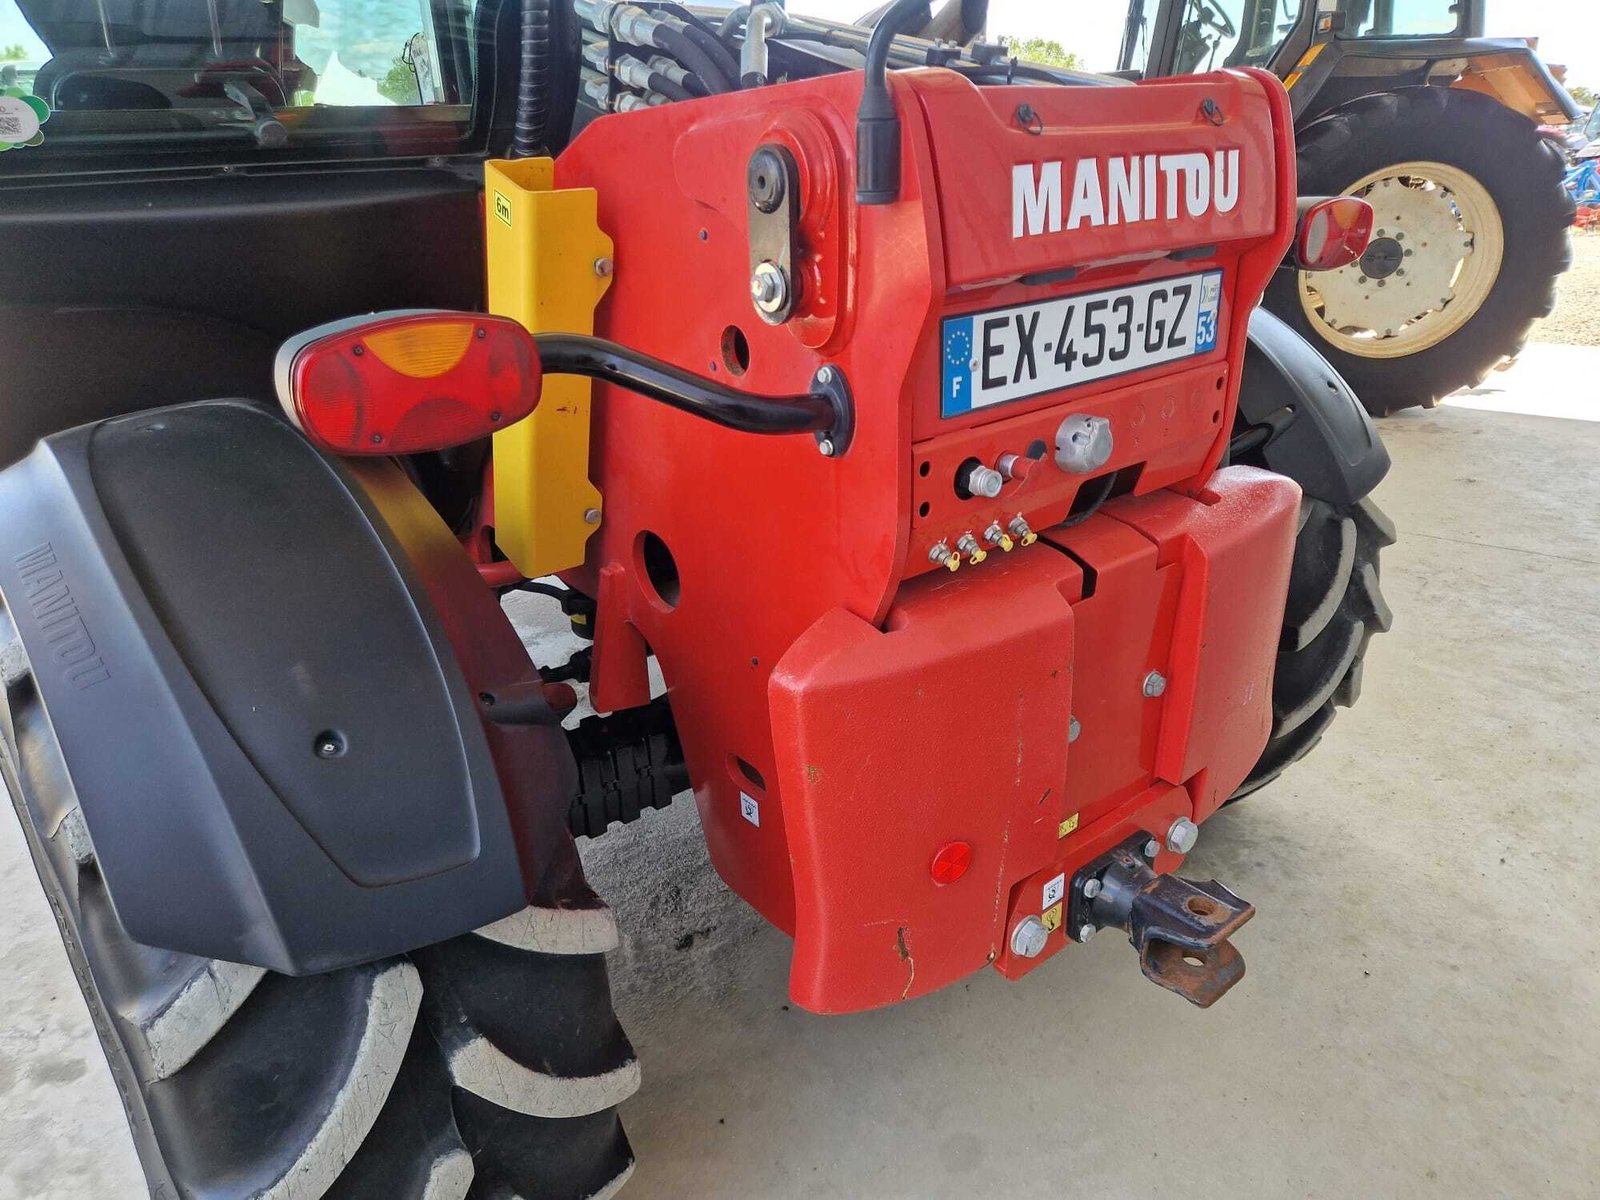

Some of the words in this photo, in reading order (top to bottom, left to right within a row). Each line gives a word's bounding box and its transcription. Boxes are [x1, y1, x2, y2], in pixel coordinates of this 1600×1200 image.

[496, 196, 509, 220] 6m
[1012, 150, 1239, 238] MANITOU
[982, 284, 1192, 390] EX-453-GZ
[1197, 313, 1215, 345] 53
[952, 376, 963, 398] F
[15, 541, 111, 690] MANITOU
